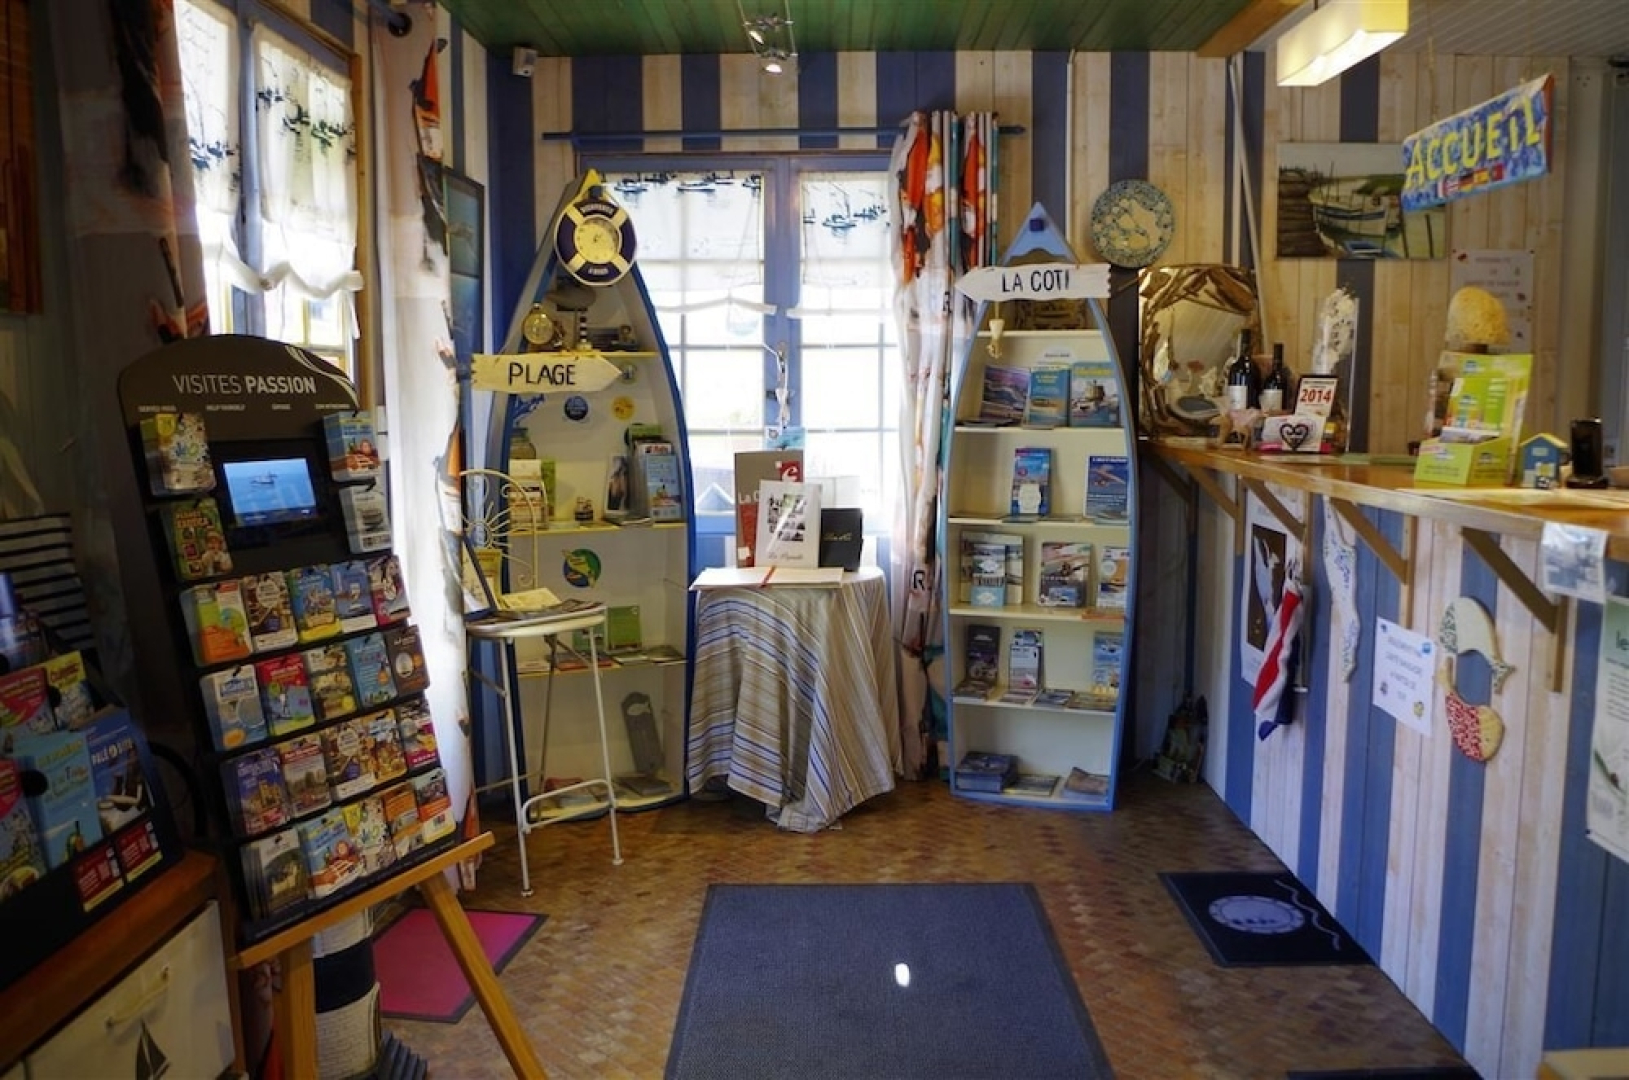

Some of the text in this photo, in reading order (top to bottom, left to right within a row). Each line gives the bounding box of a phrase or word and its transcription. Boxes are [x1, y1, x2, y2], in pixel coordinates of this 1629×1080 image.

[1403, 94, 1540, 190] ACCUEIL
[1001, 272, 1023, 293] LA
[172, 374, 316, 394] VISITES PASSION
[508, 362, 576, 385] PLAGE
[1299, 388, 1332, 404] 2014
